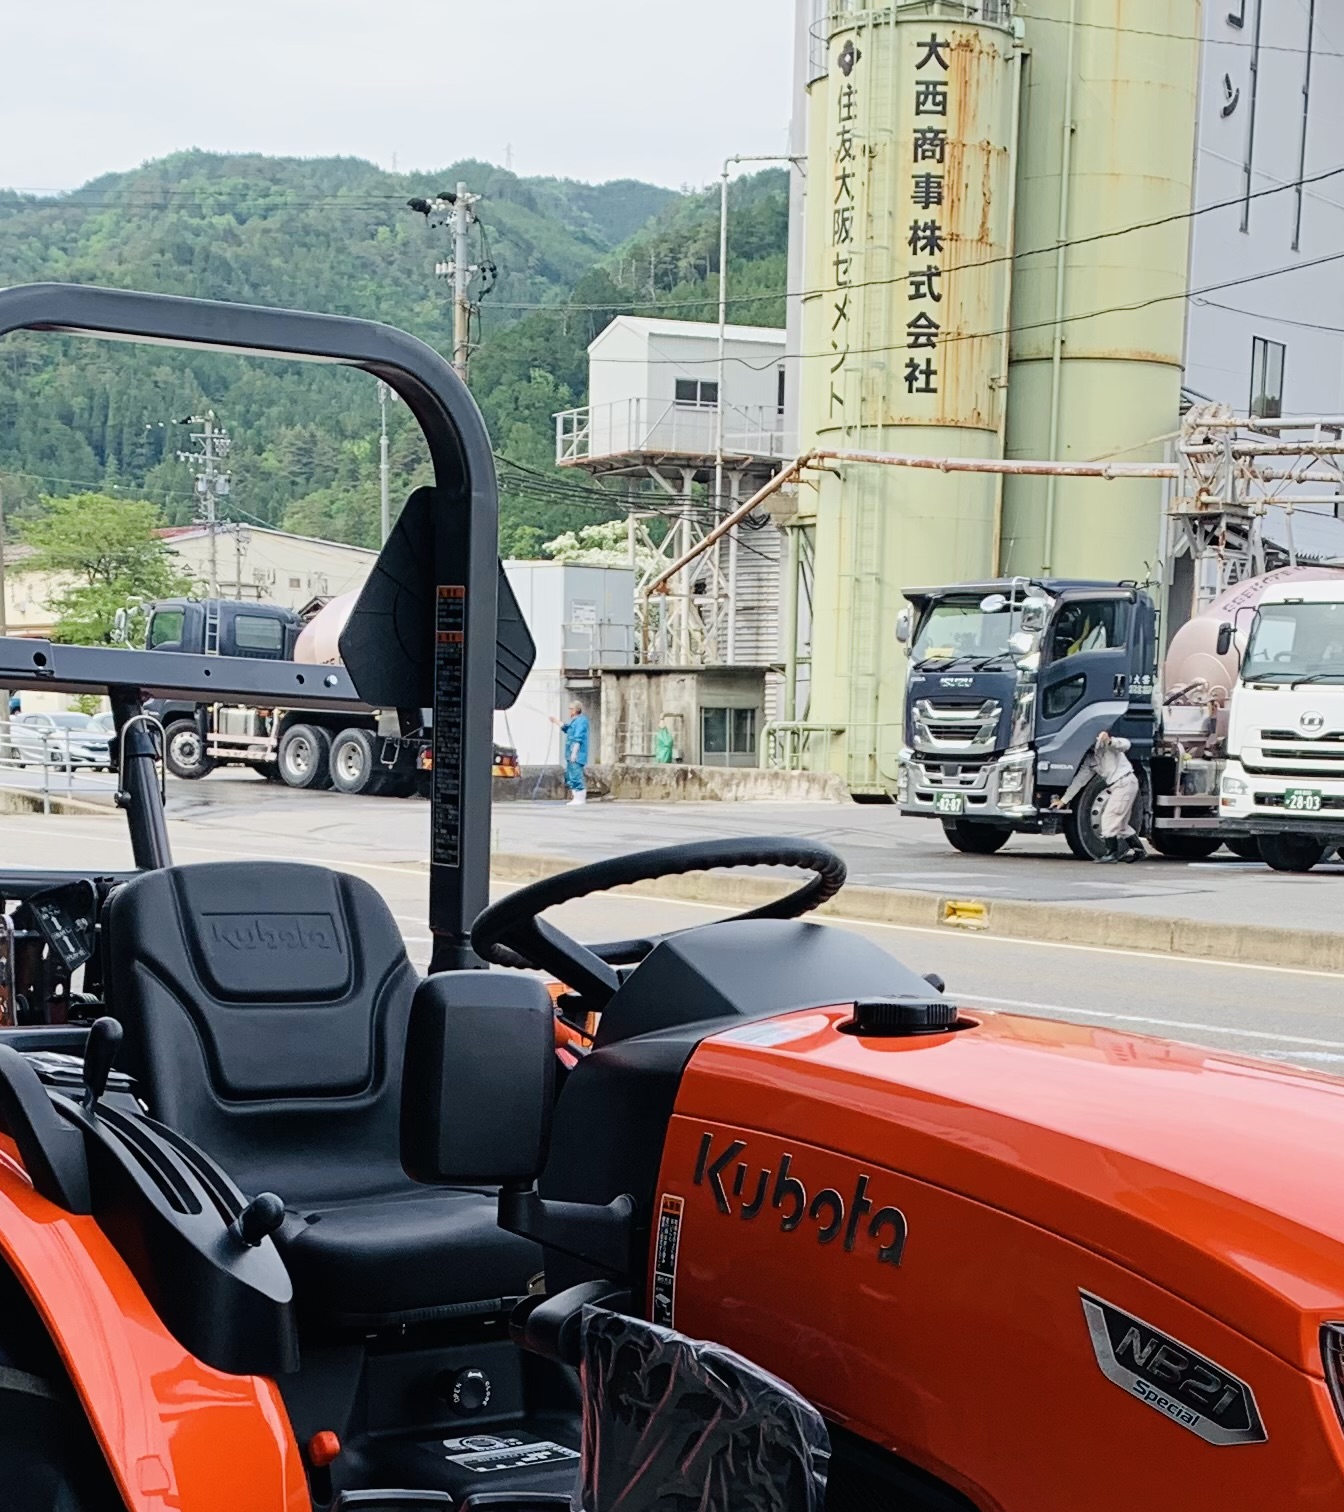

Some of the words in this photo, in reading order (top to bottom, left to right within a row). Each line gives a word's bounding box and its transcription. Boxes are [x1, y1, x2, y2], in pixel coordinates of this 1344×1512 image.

[830, 83, 858, 419] 住友大阪セメント
[903, 32, 950, 394] 大西商事株式会社
[1288, 794, 1321, 810] 28-03
[693, 1132, 908, 1267] Kubota
[1115, 1326, 1240, 1415] NB21
[1132, 1379, 1201, 1427] Special
